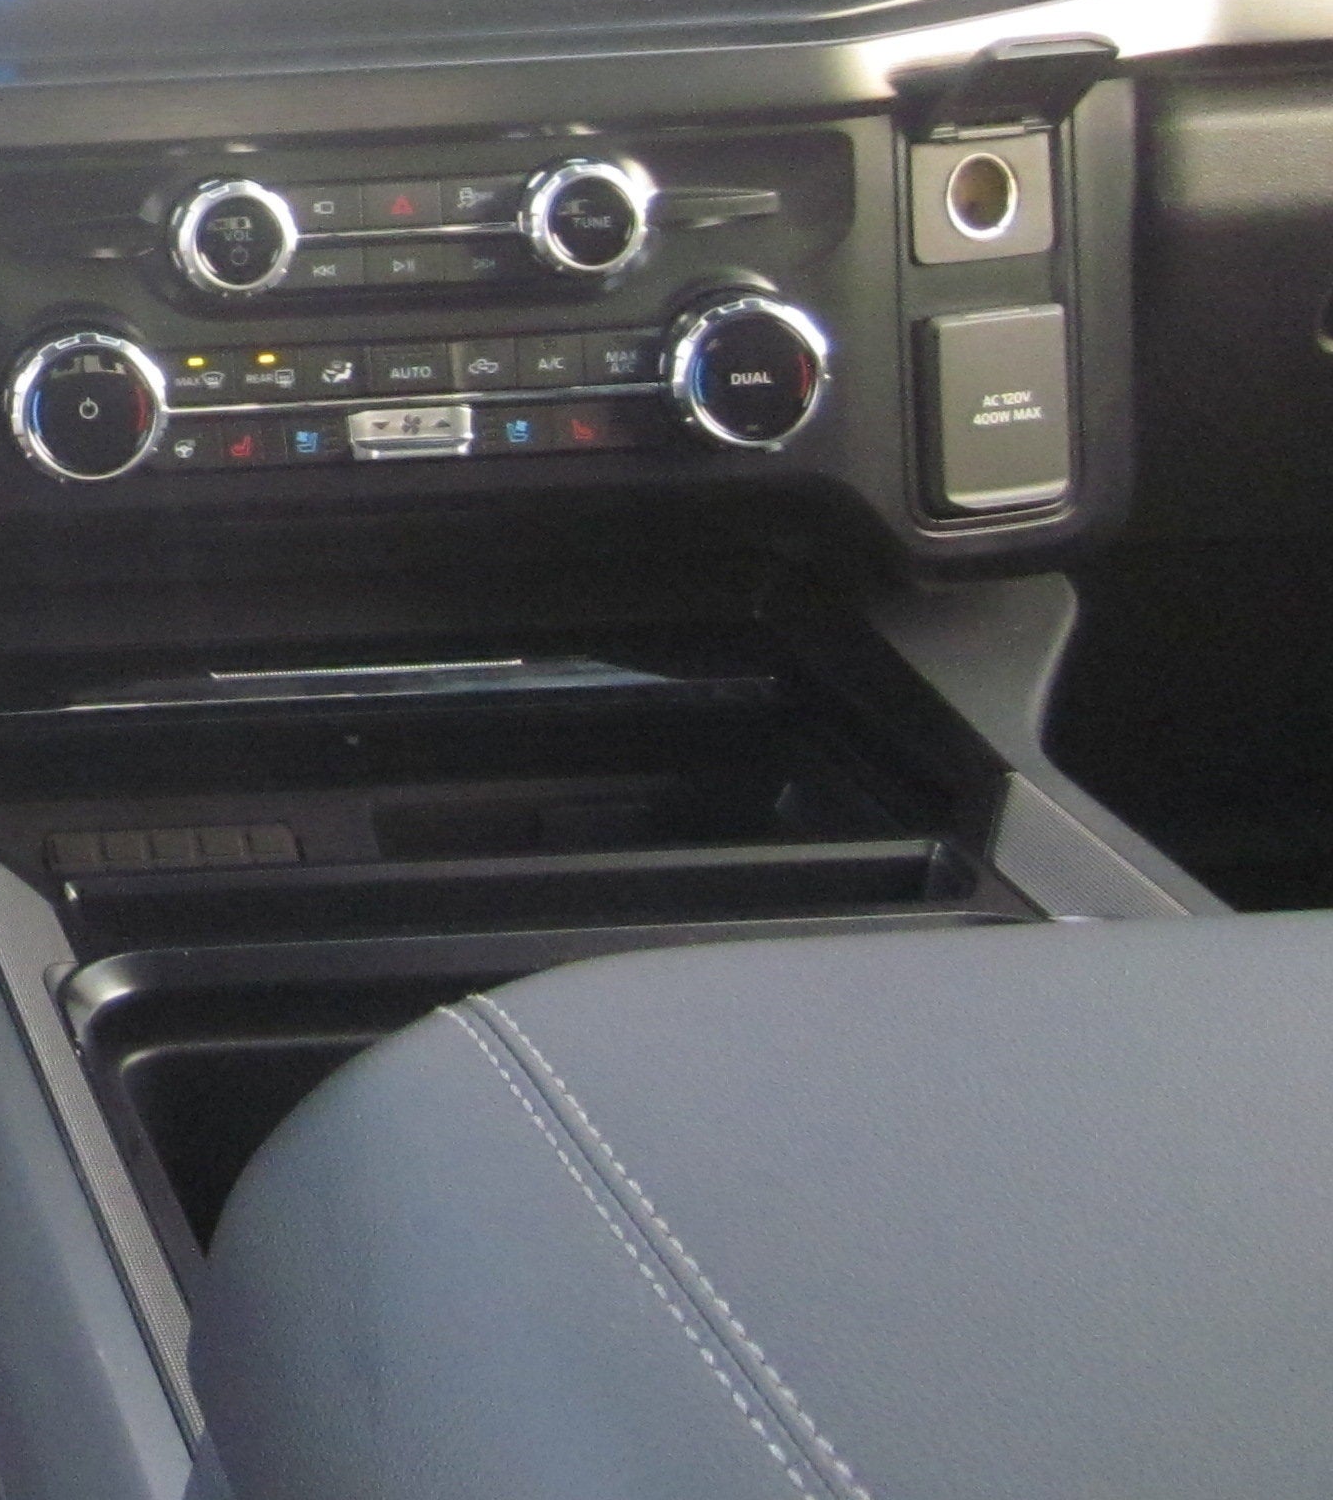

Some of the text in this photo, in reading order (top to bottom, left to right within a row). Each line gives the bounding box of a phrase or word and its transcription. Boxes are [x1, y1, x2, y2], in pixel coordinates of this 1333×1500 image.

[573, 215, 612, 229] TUNE
[223, 228, 254, 242] VOL
[537, 357, 566, 371] A/C
[388, 365, 434, 380] AUTO
[729, 371, 774, 386] DUAL
[982, 390, 1035, 408] AC 120V
[972, 406, 1043, 426] 400W MAX
